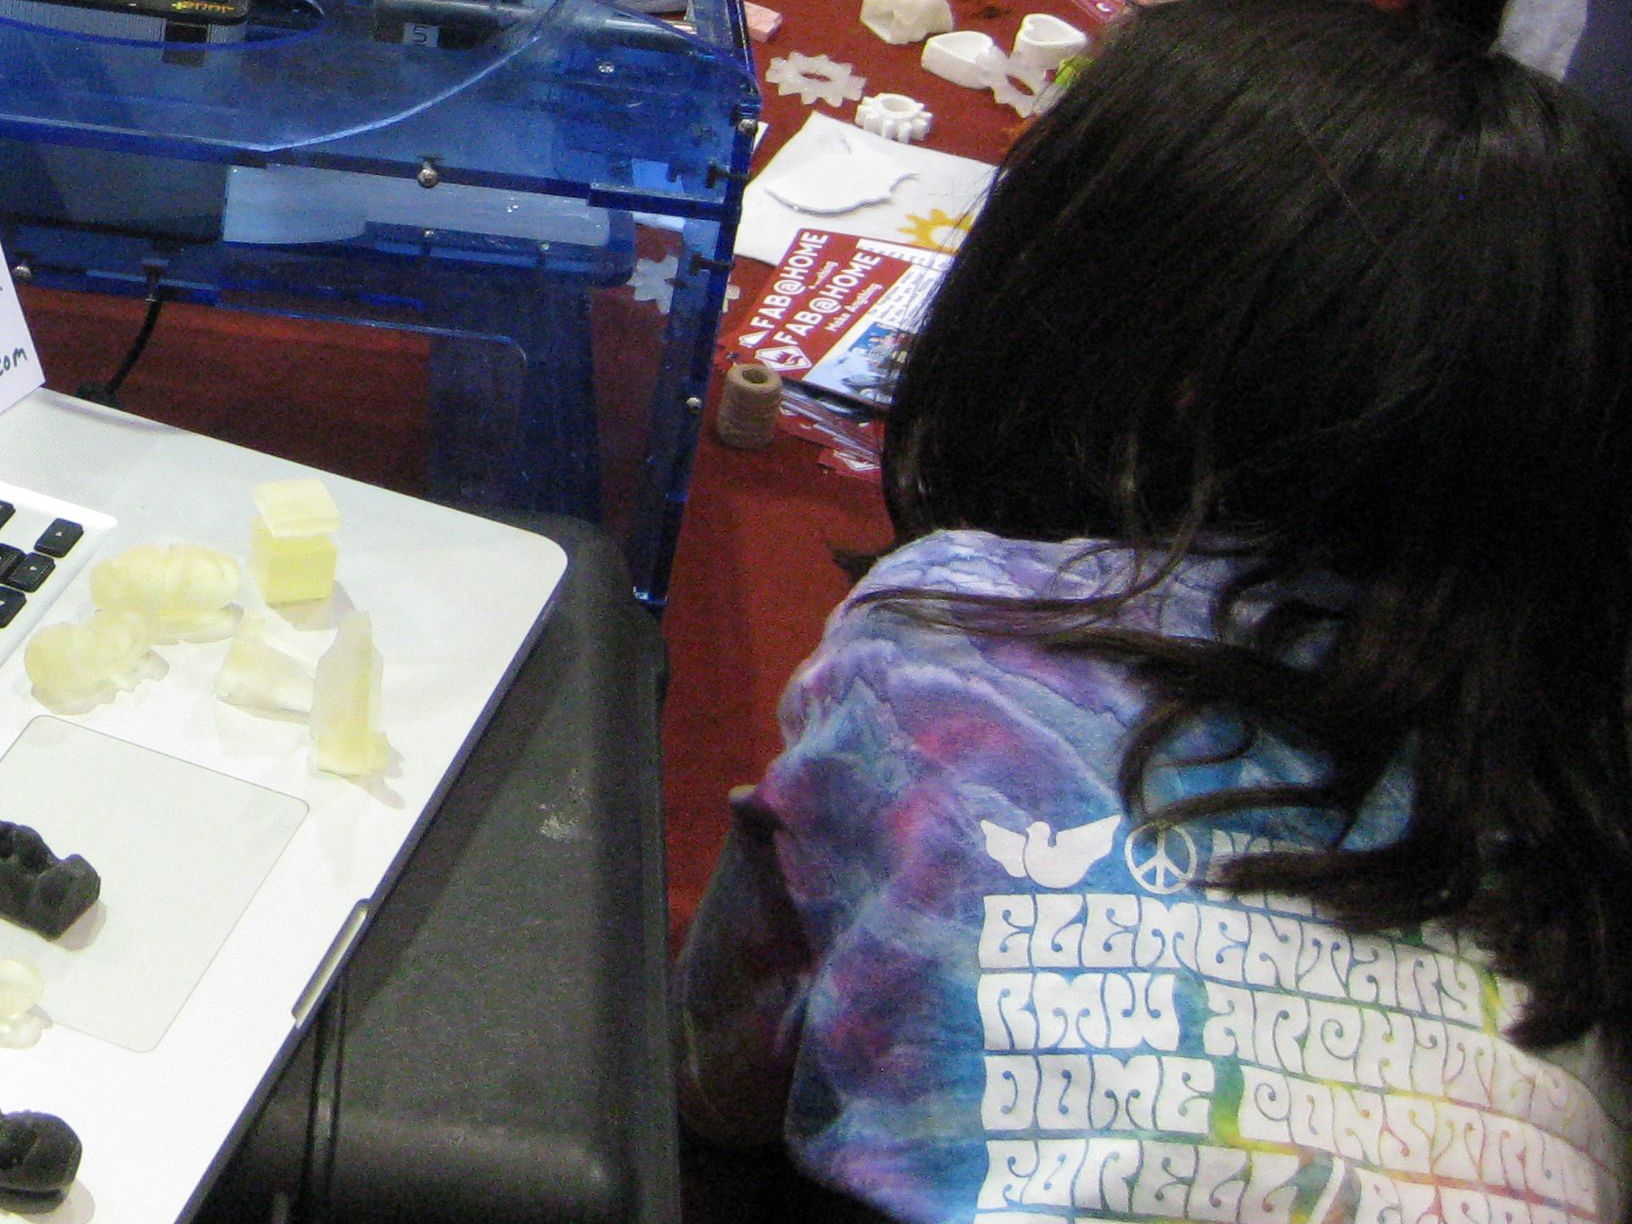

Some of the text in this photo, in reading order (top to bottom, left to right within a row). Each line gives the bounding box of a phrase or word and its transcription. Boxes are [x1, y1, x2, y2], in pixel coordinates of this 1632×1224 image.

[751, 231, 829, 329] FAB@HOME
[773, 251, 883, 346] FAB@HOME
[976, 893, 1486, 1032] ELEMENTARY
[980, 1053, 1598, 1216] DOME CONSTRU
